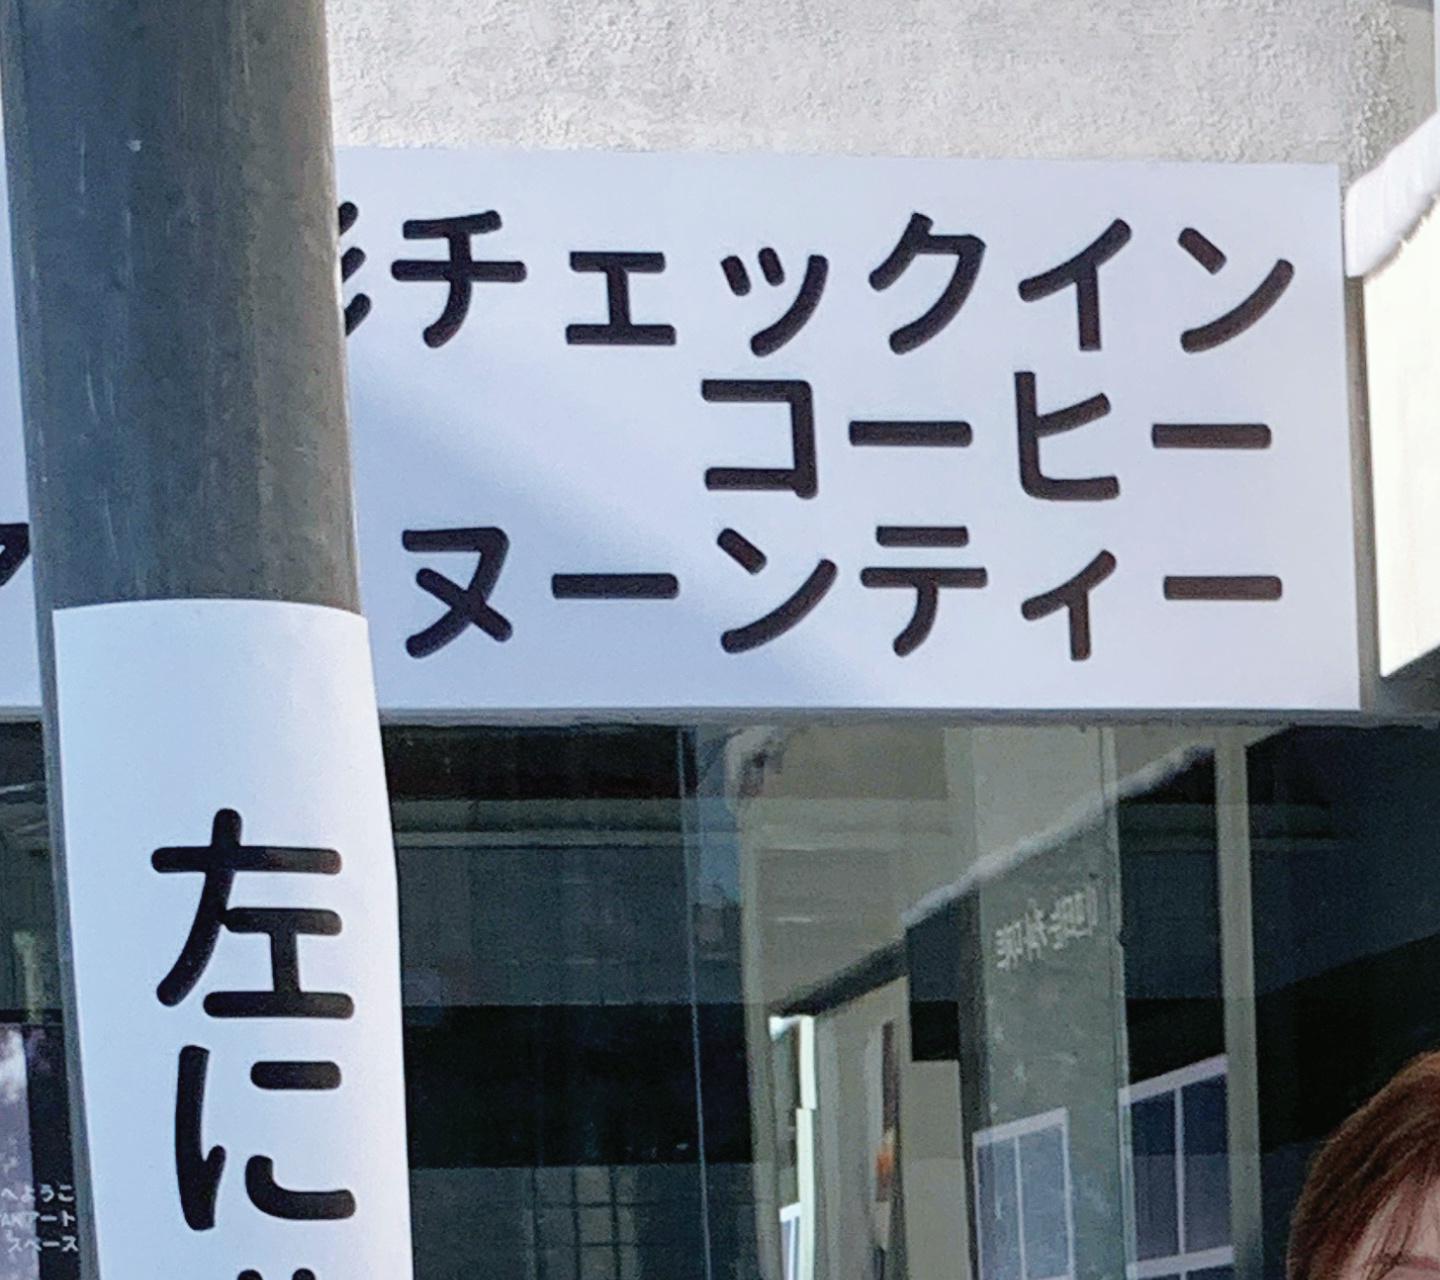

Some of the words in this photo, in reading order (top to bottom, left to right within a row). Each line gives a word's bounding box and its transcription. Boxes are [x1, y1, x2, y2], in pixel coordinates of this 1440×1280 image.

[338, 201, 1295, 357] チェックイン
[700, 370, 1273, 499] コーヒー
